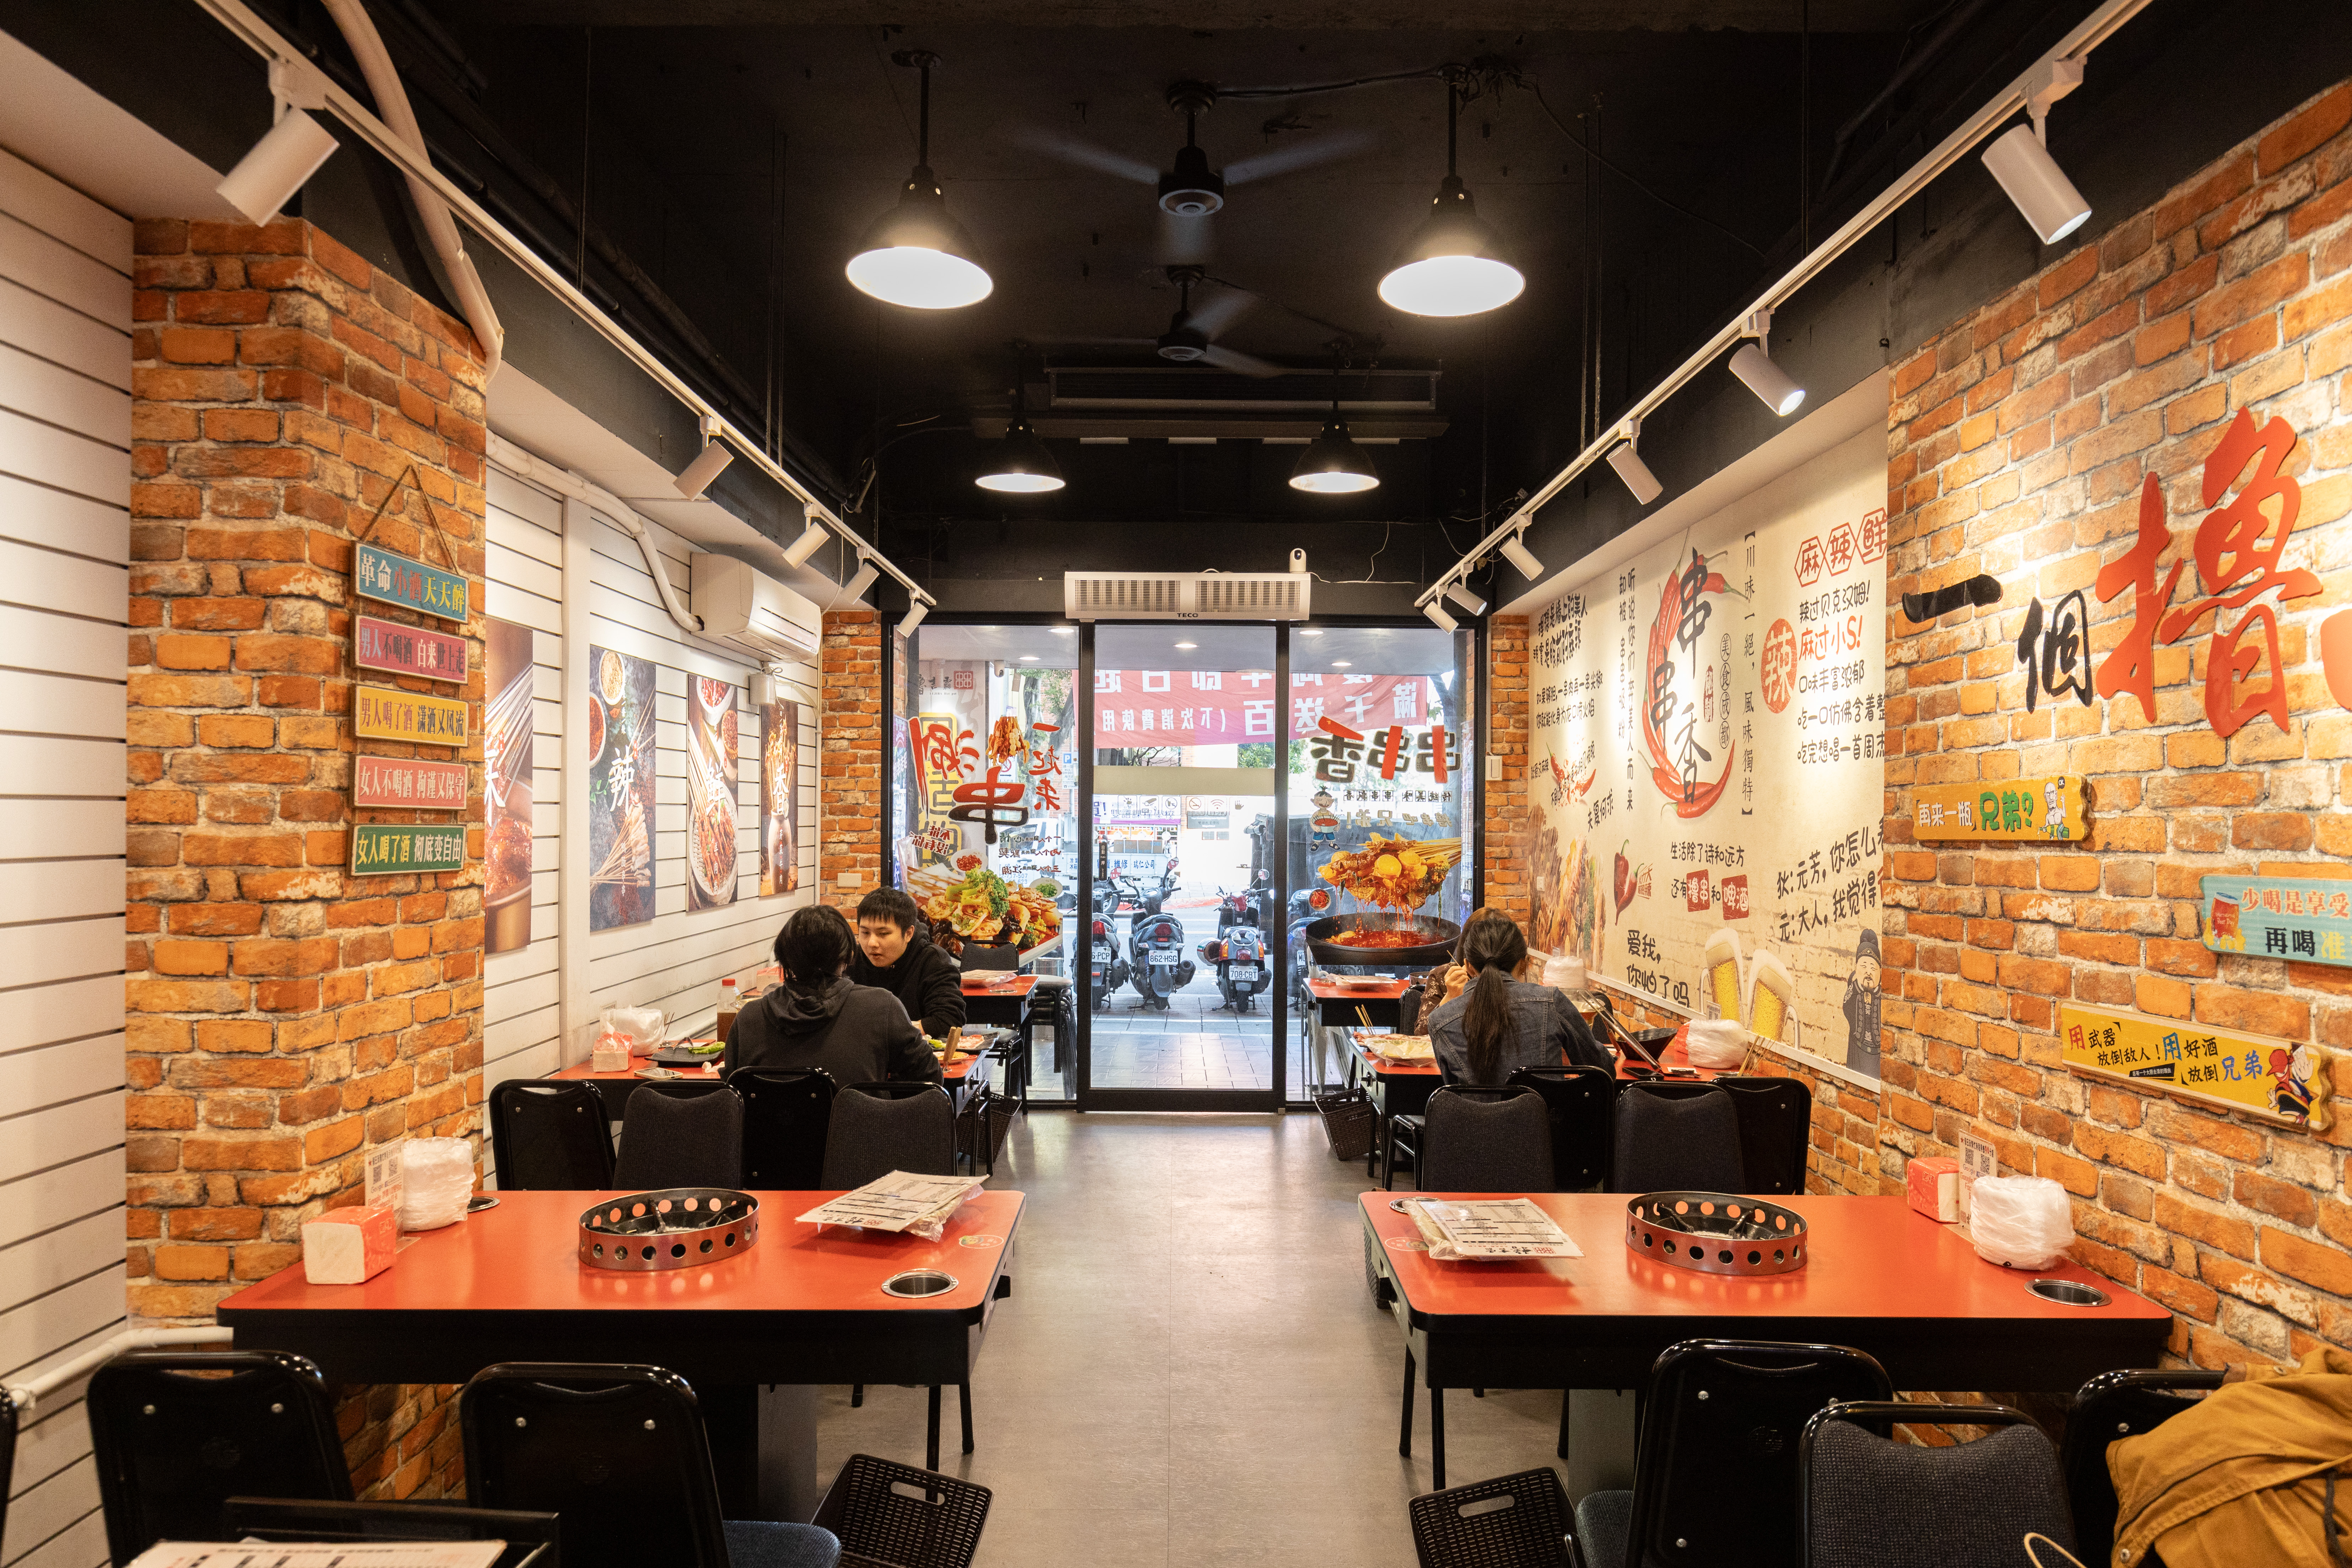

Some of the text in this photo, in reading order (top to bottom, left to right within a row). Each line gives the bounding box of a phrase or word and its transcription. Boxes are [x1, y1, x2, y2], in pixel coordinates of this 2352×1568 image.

[360, 552, 465, 614] 革命小酒天天醉
[1902, 407, 2352, 737] 一個擼
[1800, 580, 1870, 623] 辣过贝克汉姆！
[360, 627, 464, 675] 男人不喝酒 白来世上走
[1765, 626, 1794, 704] 辣
[1651, 546, 1712, 804] 串串香
[1720, 634, 1731, 748] 美食成都
[1799, 660, 1864, 693] 口味丰富浓郁
[361, 696, 413, 731] 男人喝了酒
[360, 764, 412, 800] 女人不喝酒
[417, 771, 463, 802] 拘谨又保守
[609, 745, 634, 817] 辣
[773, 763, 788, 815] 香
[1588, 788, 1613, 833] 夫复何求
[357, 832, 461, 866] 女人喝了酒 彻底变自由
[1671, 842, 1744, 867] 生活除了诗和远方
[2242, 887, 2350, 919] 少喝是享受
[2265, 927, 2352, 959] 再喝准
[1627, 963, 1689, 1008] 你怕了吗
